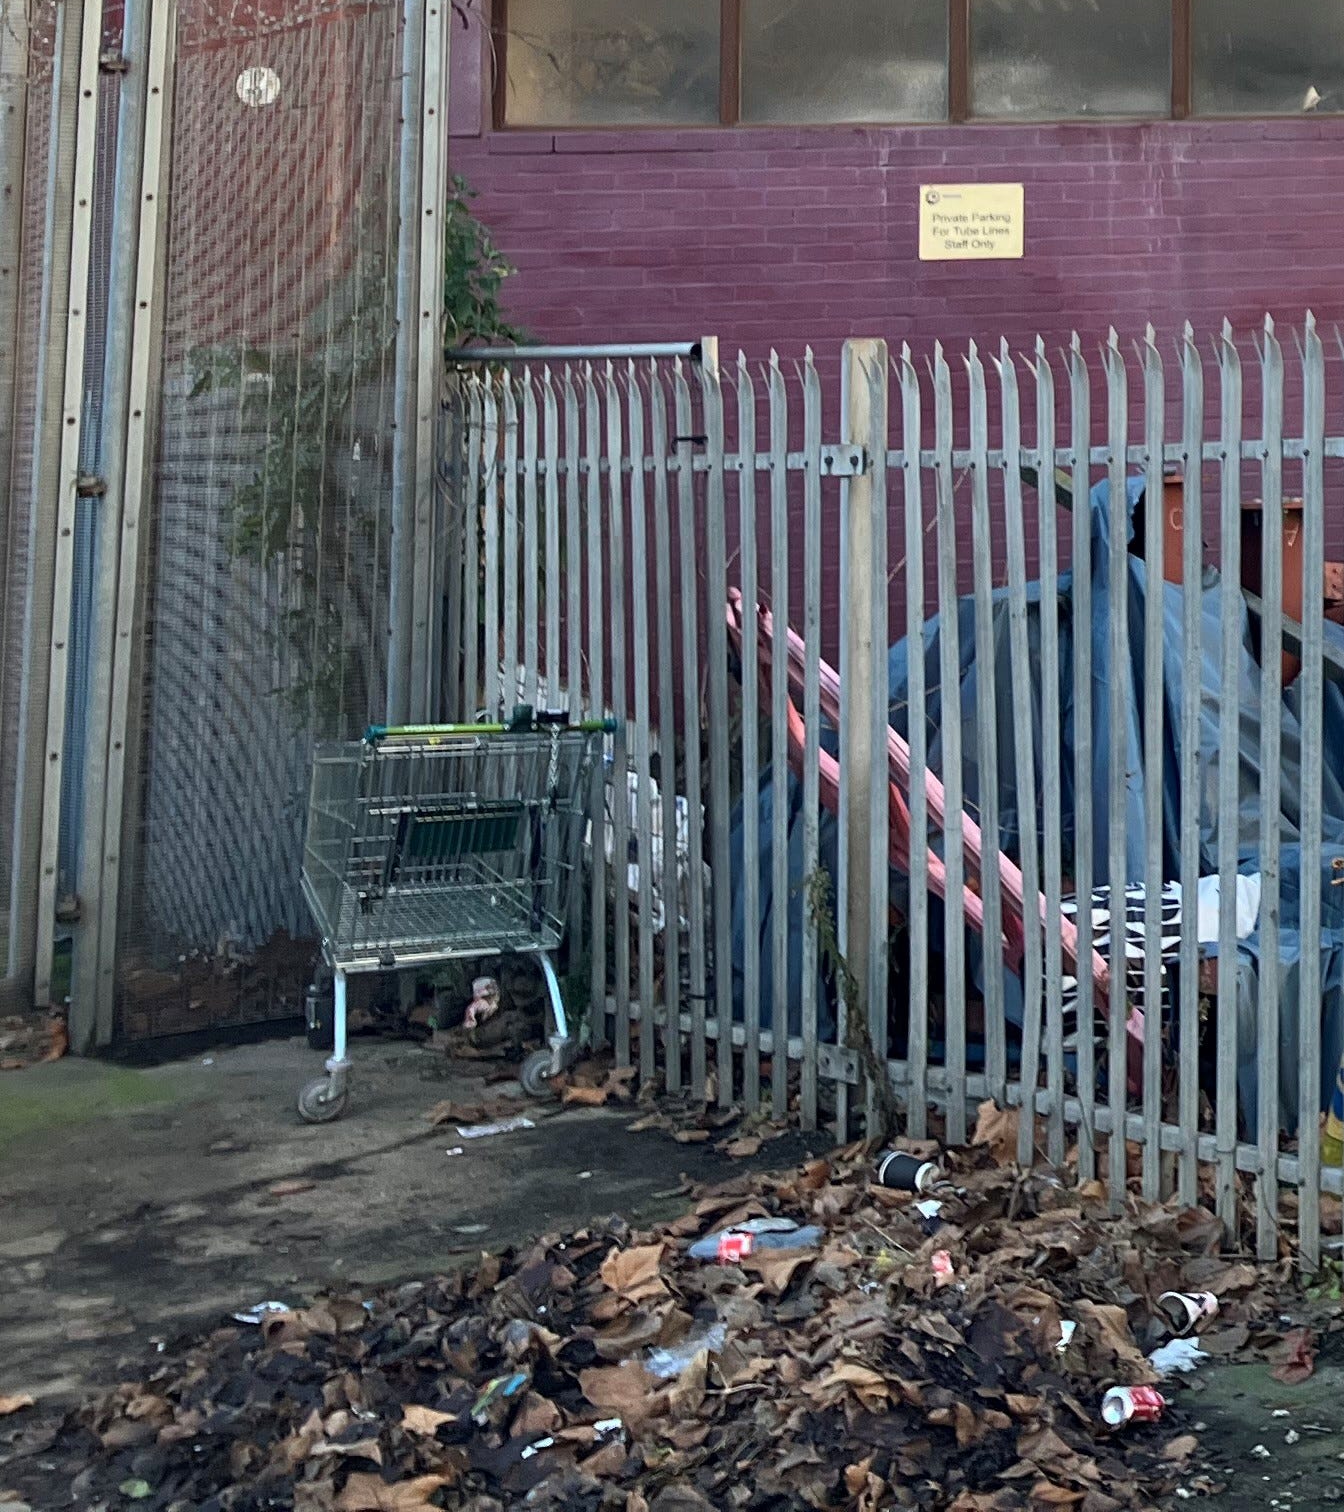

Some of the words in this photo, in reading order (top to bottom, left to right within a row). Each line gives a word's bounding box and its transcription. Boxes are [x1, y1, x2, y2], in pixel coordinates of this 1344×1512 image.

[932, 213, 969, 223] Private
[972, 212, 1011, 224] Parking
[932, 227, 949, 236] For
[954, 226, 979, 236] Tube
[983, 226, 1010, 236] Lines
[944, 238, 968, 249] Staff
[971, 239, 995, 250] Only
